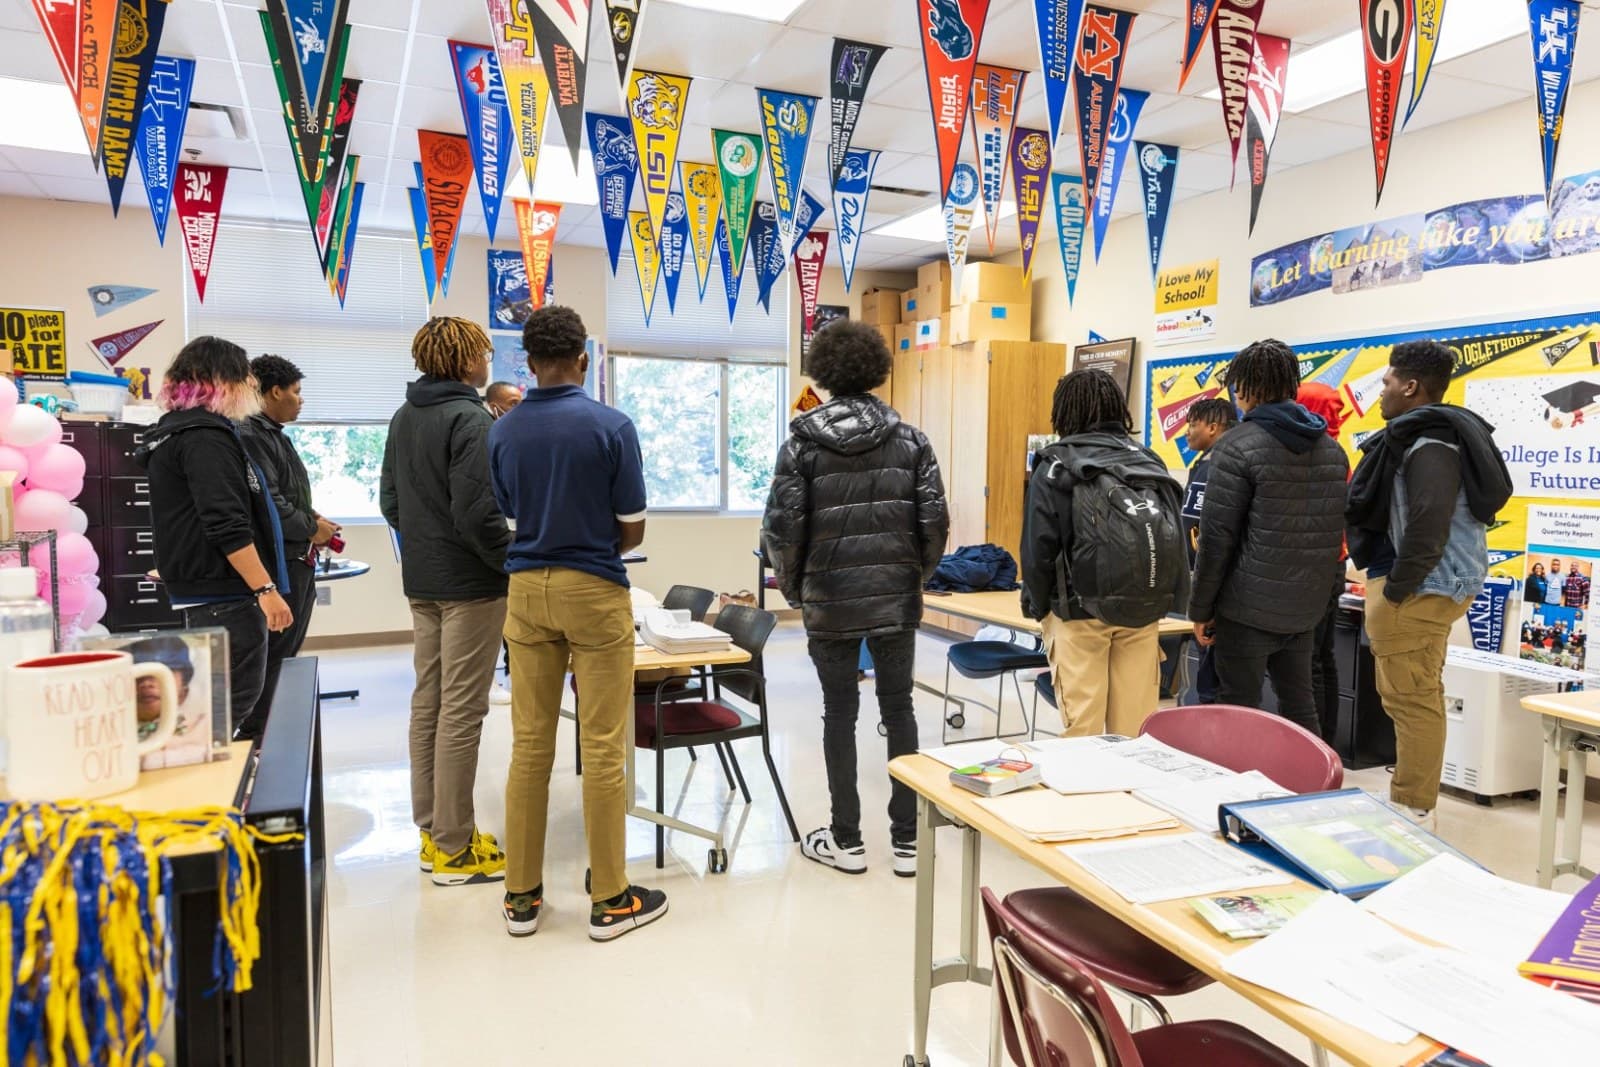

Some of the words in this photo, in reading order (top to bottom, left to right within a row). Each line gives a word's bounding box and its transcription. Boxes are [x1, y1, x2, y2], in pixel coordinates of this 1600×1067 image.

[1055, 0, 1068, 40] NESSEE
[1420, 0, 1436, 40] &T
[1539, 7, 1568, 65] UK
[553, 44, 571, 106] ALABAMA
[1050, 42, 1067, 81] STATE
[1217, 8, 1255, 138] ALABAMA
[105, 64, 141, 122] NOTRE
[521, 82, 533, 120] YELLOW
[832, 98, 843, 123] STATE
[844, 100, 860, 128] MIDDLE
[939, 74, 960, 134] BISON
[987, 71, 1001, 122] ILLINOIS
[1381, 70, 1391, 142] GEORGIA
[1541, 71, 1562, 130] WILDCATS
[521, 122, 534, 158] JACKETS
[1088, 81, 1103, 167] AUBURN
[103, 127, 132, 179] DAME
[146, 127, 158, 189] WILDCATS
[156, 126, 168, 189] KENTUCKY
[480, 106, 498, 198] MUSTANGS
[646, 134, 666, 195] LSU
[762, 96, 790, 211] JAGUARS
[838, 131, 851, 165] GEORGIA
[994, 127, 1002, 202] FIGHTING
[427, 178, 464, 258] SYRACUSE
[603, 178, 613, 212] STATE
[612, 176, 624, 219] GEORGIA
[1025, 174, 1040, 222] LSU
[182, 217, 200, 270] COLLEGE
[841, 197, 860, 244] Duke
[954, 208, 971, 265] FISK
[1059, 181, 1086, 281] COLUMBIA
[198, 212, 216, 276] MOREHOUSE
[531, 240, 549, 285] USMC
[662, 227, 673, 277] BRONCOS
[1270, 262, 1302, 289] Let
[1309, 234, 1409, 275] learning
[1485, 223, 1545, 250] you
[800, 261, 819, 316] HARVARD
[1158, 276, 1162, 289] I
[1165, 273, 1191, 287] Love
[1194, 267, 1214, 284] My
[1163, 285, 1206, 304] School!
[27, 314, 59, 330] place
[31, 329, 61, 342] for
[1156, 320, 1179, 333] School
[0, 343, 63, 370] ATE
[1463, 334, 1542, 366] OGLETHORPE
[1501, 445, 1559, 467] ollege
[1564, 446, 1582, 463] Is
[1529, 472, 1600, 490] Future
[1145, 522, 1155, 550] UNDER
[1541, 528, 1571, 537] Quarterly
[1571, 530, 1593, 538] Report
[1571, 513, 1600, 521] Academy
[1148, 551, 1157, 588] ARMOUR
[1469, 587, 1492, 650] KENTU
[43, 681, 94, 716] READ
[74, 708, 126, 749] HEART
[82, 745, 123, 782] OUT
